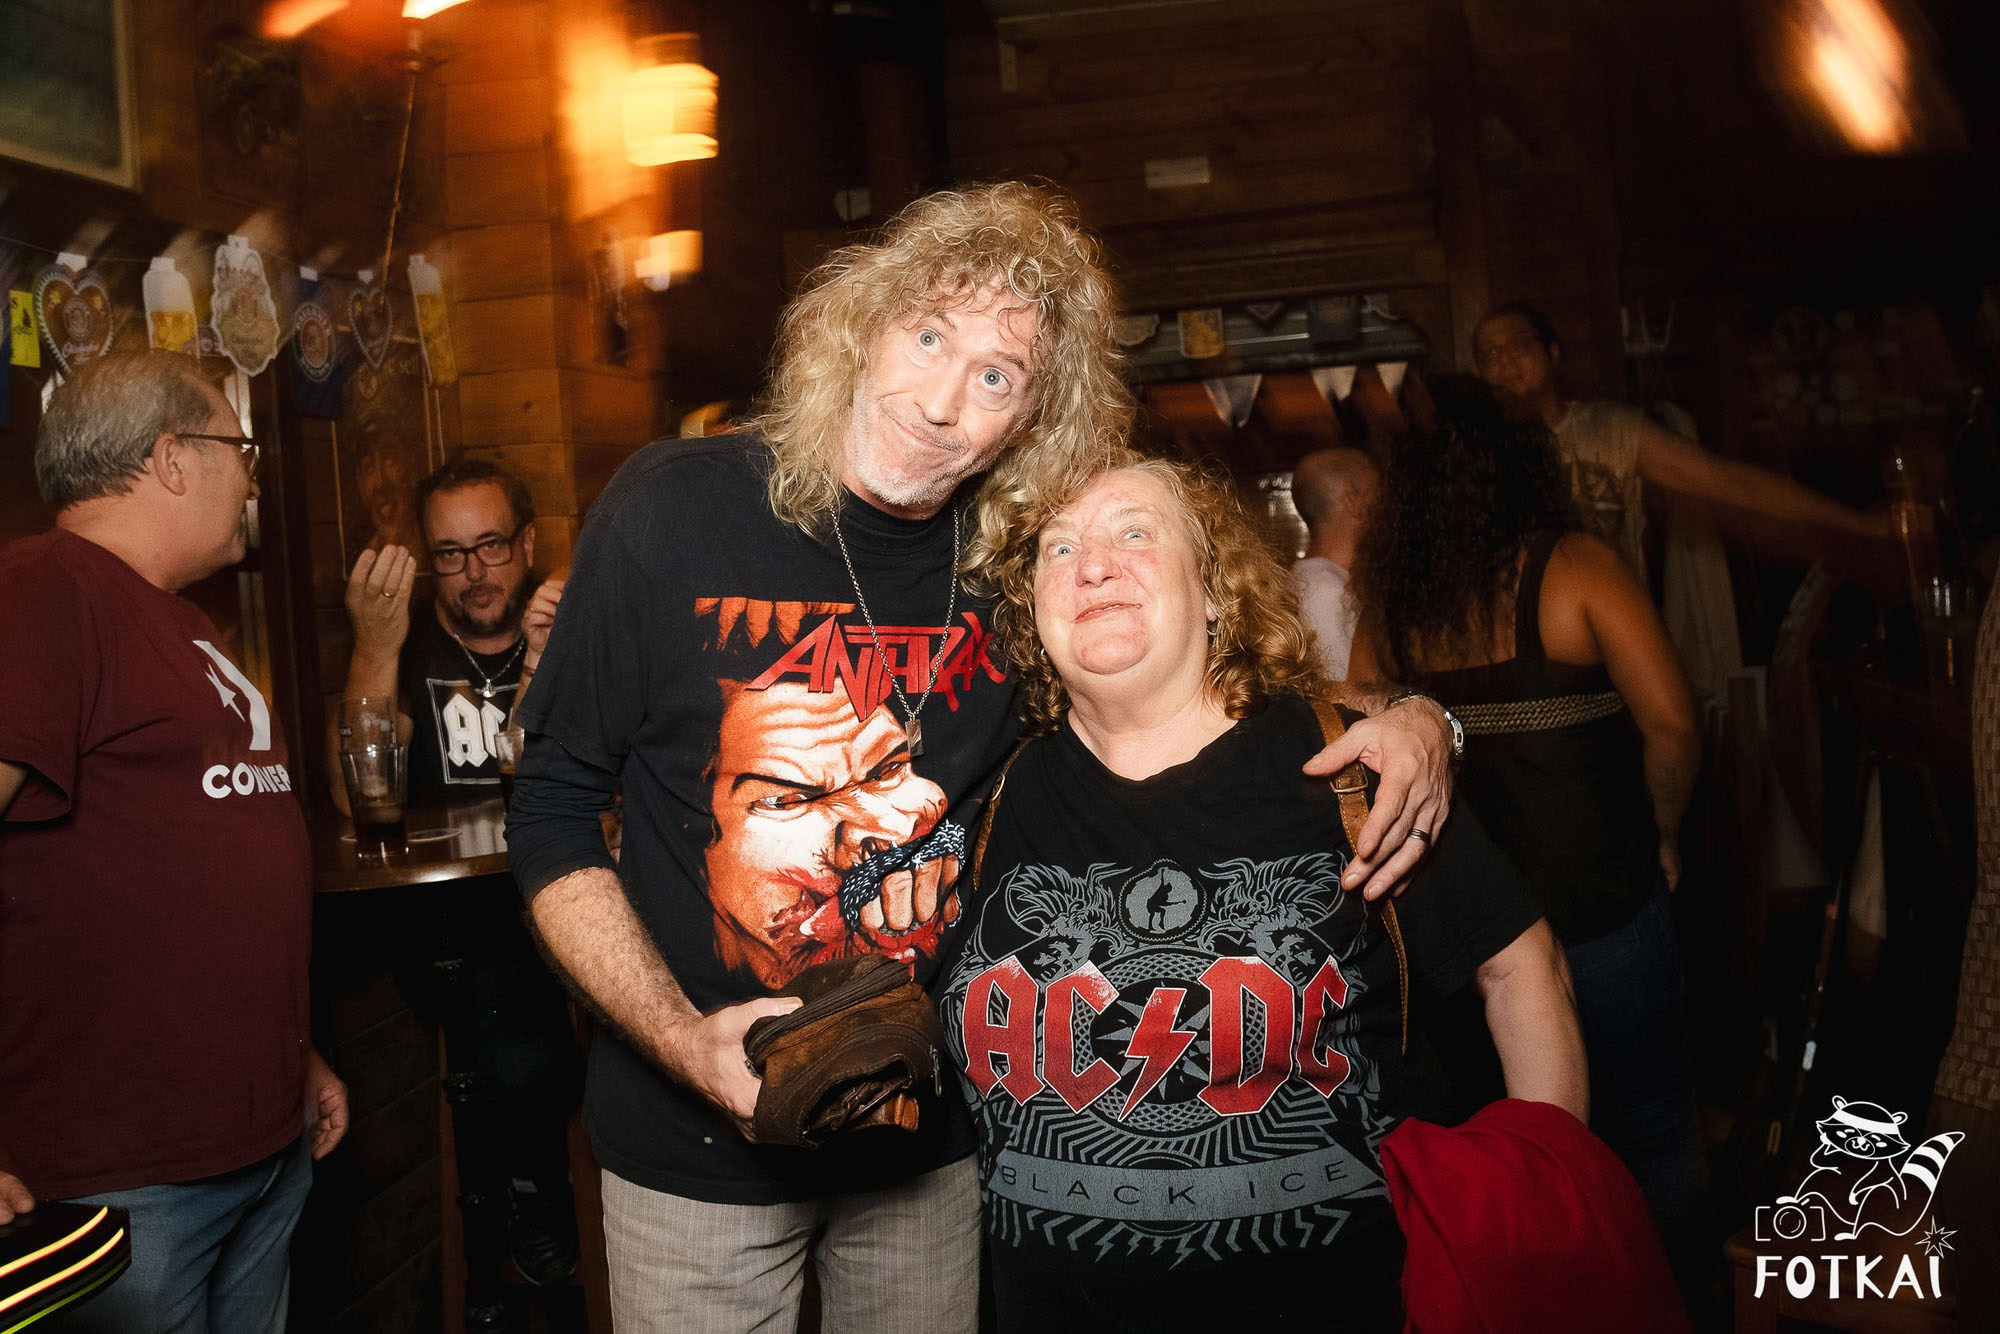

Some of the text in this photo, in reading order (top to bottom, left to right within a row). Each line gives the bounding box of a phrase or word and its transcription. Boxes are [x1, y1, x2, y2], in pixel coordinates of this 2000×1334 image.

[744, 612, 1006, 722] ANTHRAX
[1001, 1160, 1348, 1206] BLACK ICE
